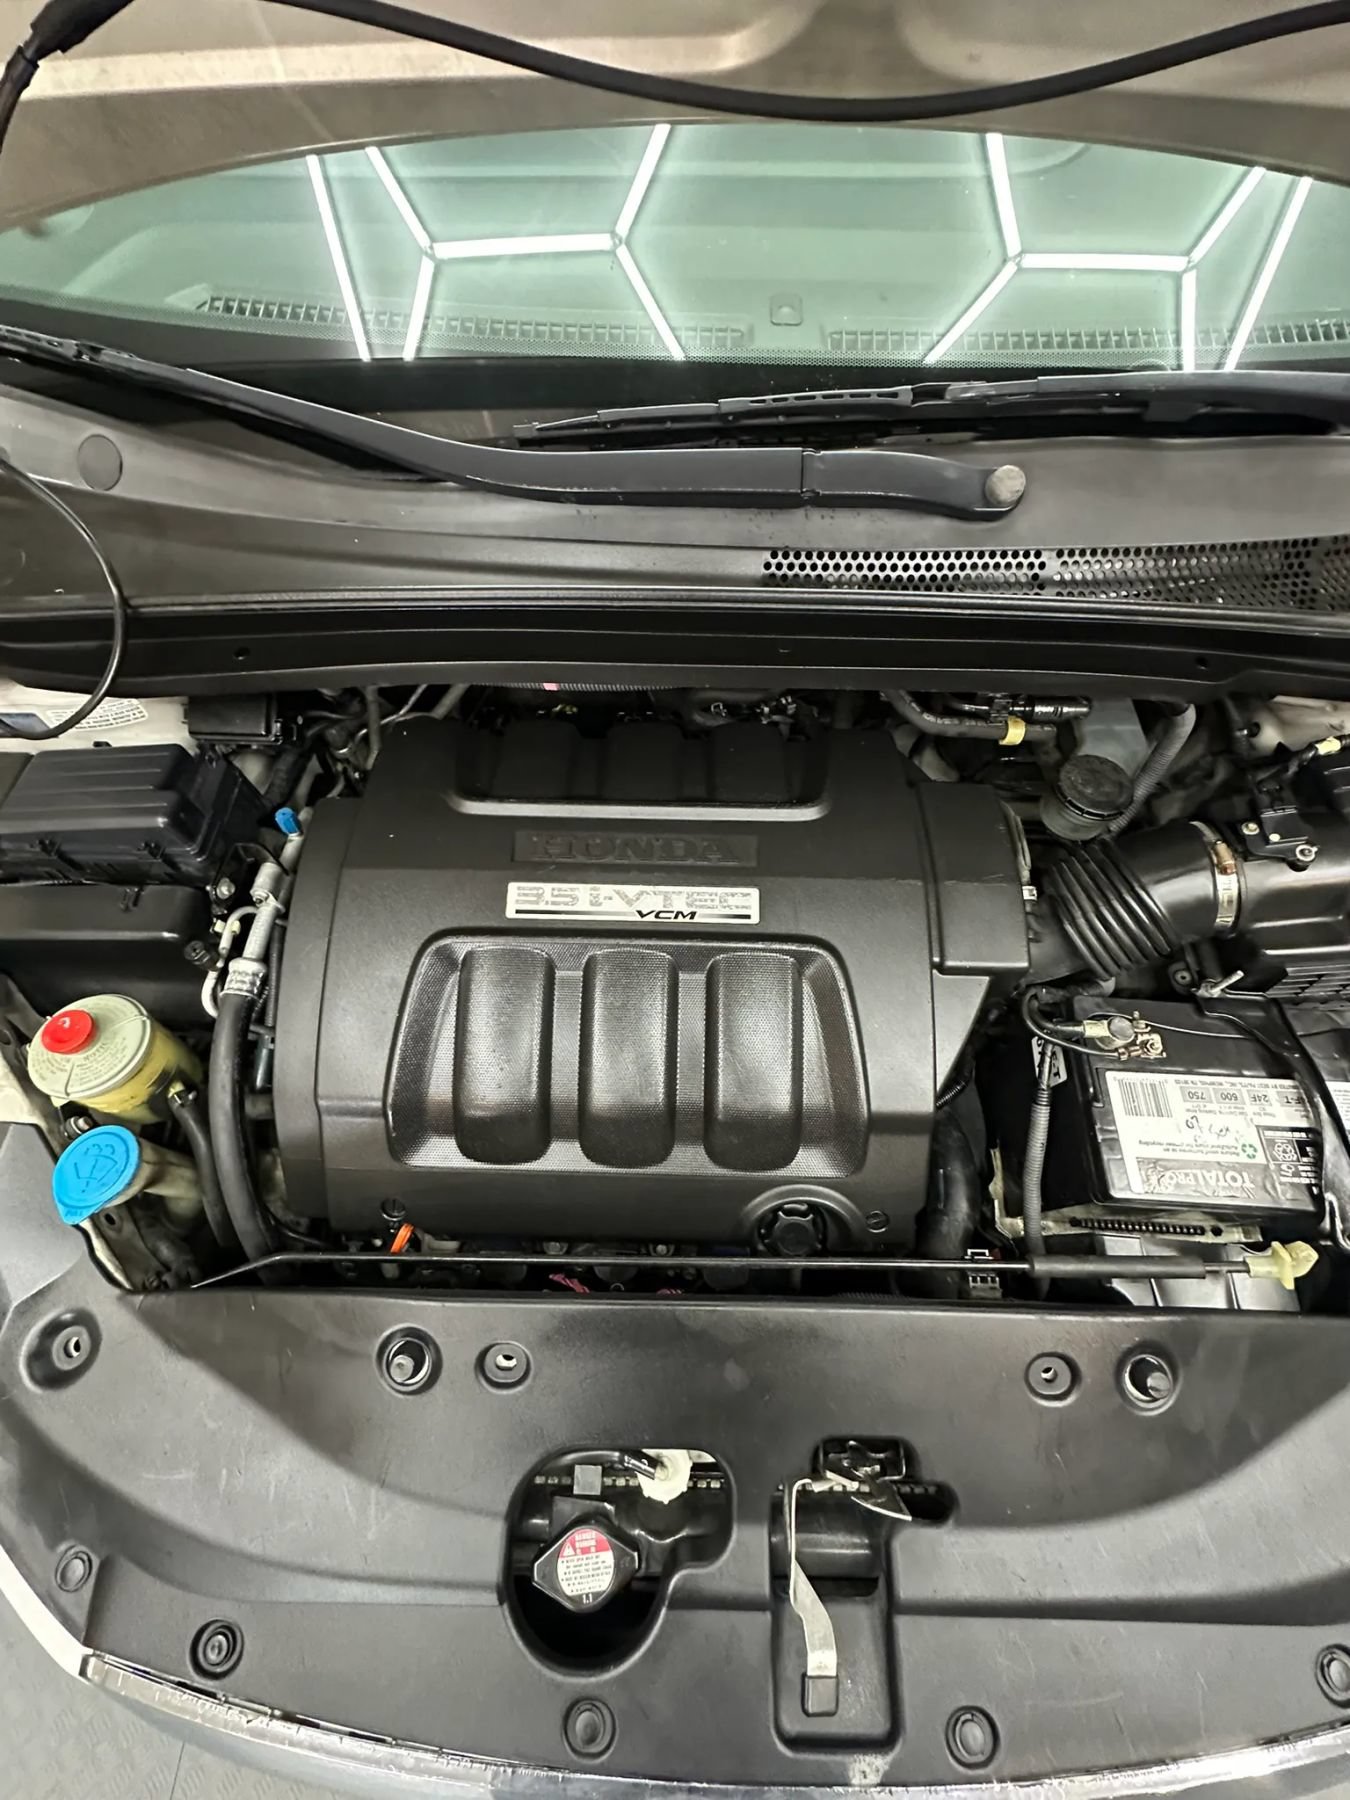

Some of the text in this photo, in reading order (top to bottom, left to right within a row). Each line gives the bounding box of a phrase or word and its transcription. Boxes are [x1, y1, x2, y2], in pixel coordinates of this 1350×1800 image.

[531, 834, 742, 864] HONDA
[515, 885, 752, 909] 3.5 i-VTEC
[635, 909, 698, 921] VCM
[1187, 1090, 1206, 1100] 750
[1220, 1091, 1239, 1101] 600
[1250, 1094, 1269, 1104] 24F
[582, 1593, 593, 1604] 1.1
